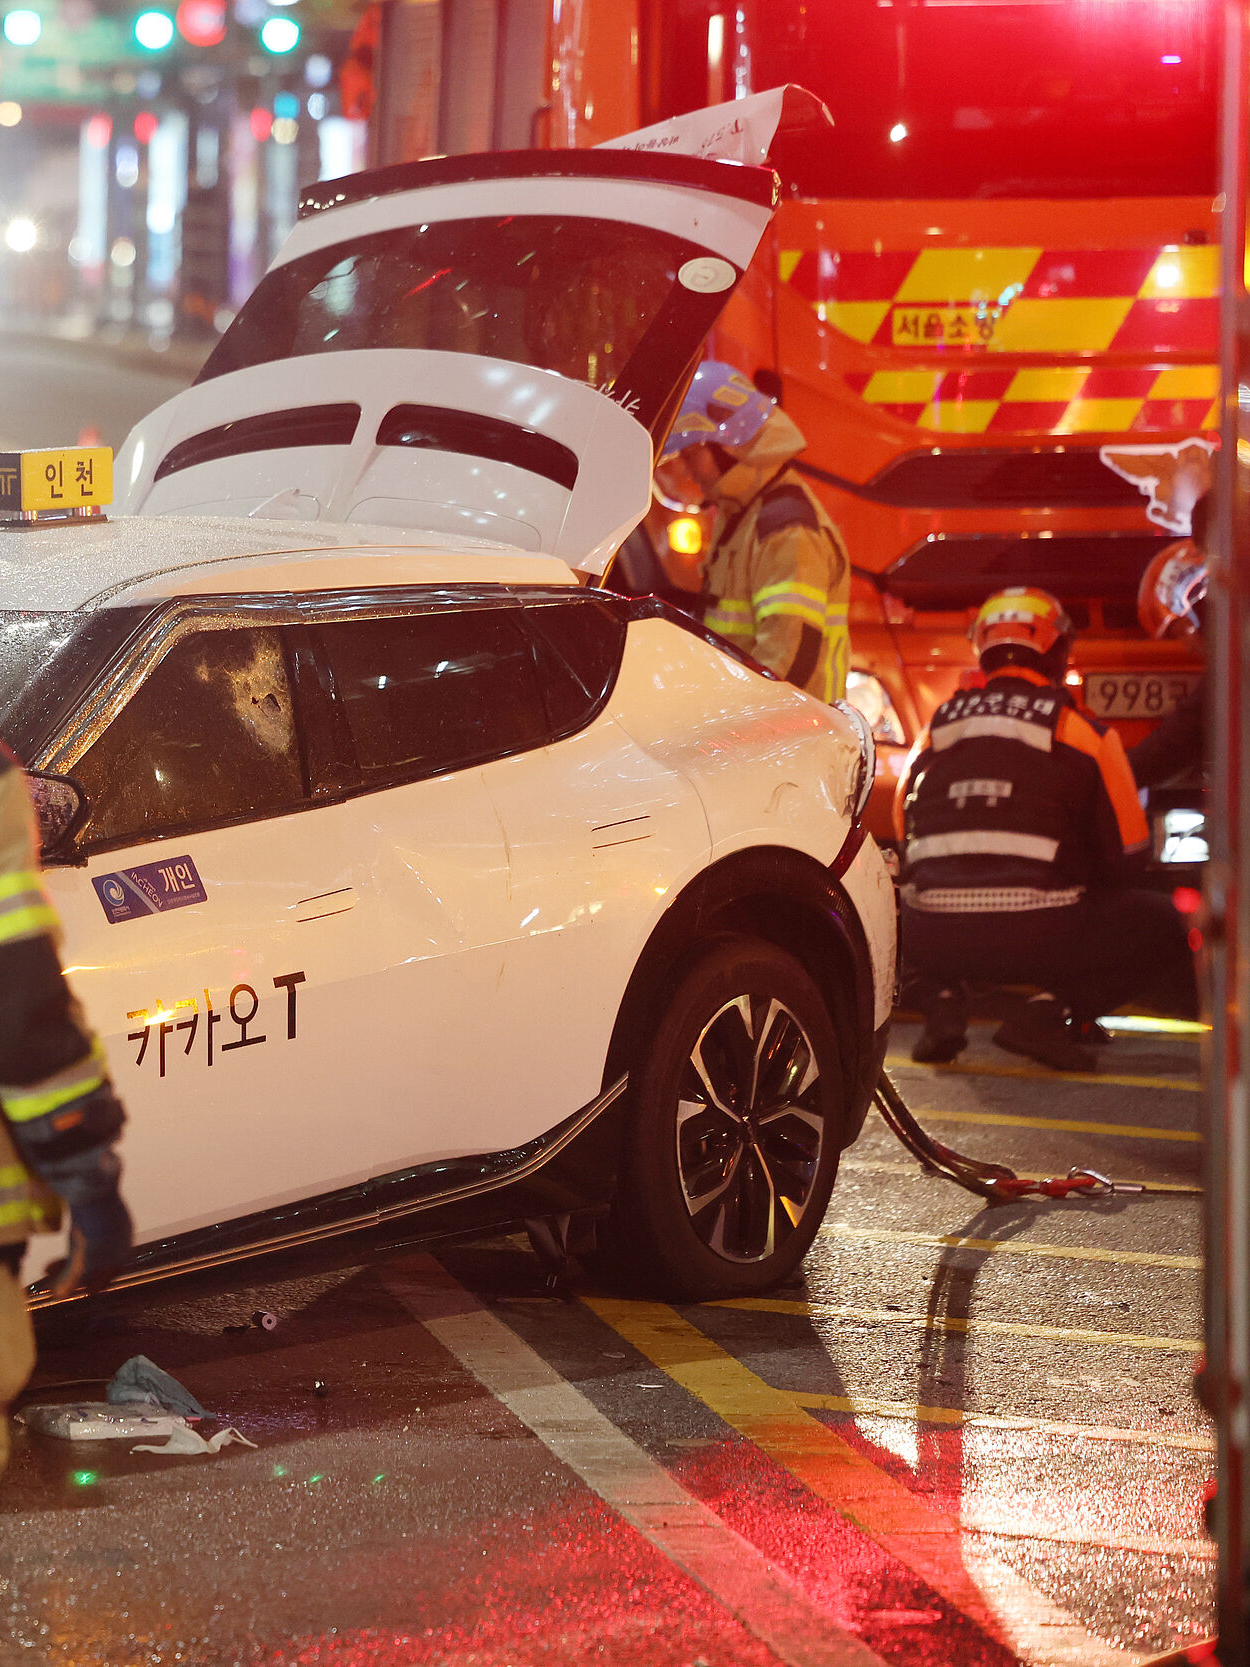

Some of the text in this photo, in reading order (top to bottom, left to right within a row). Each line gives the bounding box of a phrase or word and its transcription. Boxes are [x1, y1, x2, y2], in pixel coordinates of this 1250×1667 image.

[45, 458, 94, 499] 인천
[130, 871, 164, 908] INCHEON
[157, 862, 196, 893] 개인
[126, 970, 307, 1078] 카카오 T
